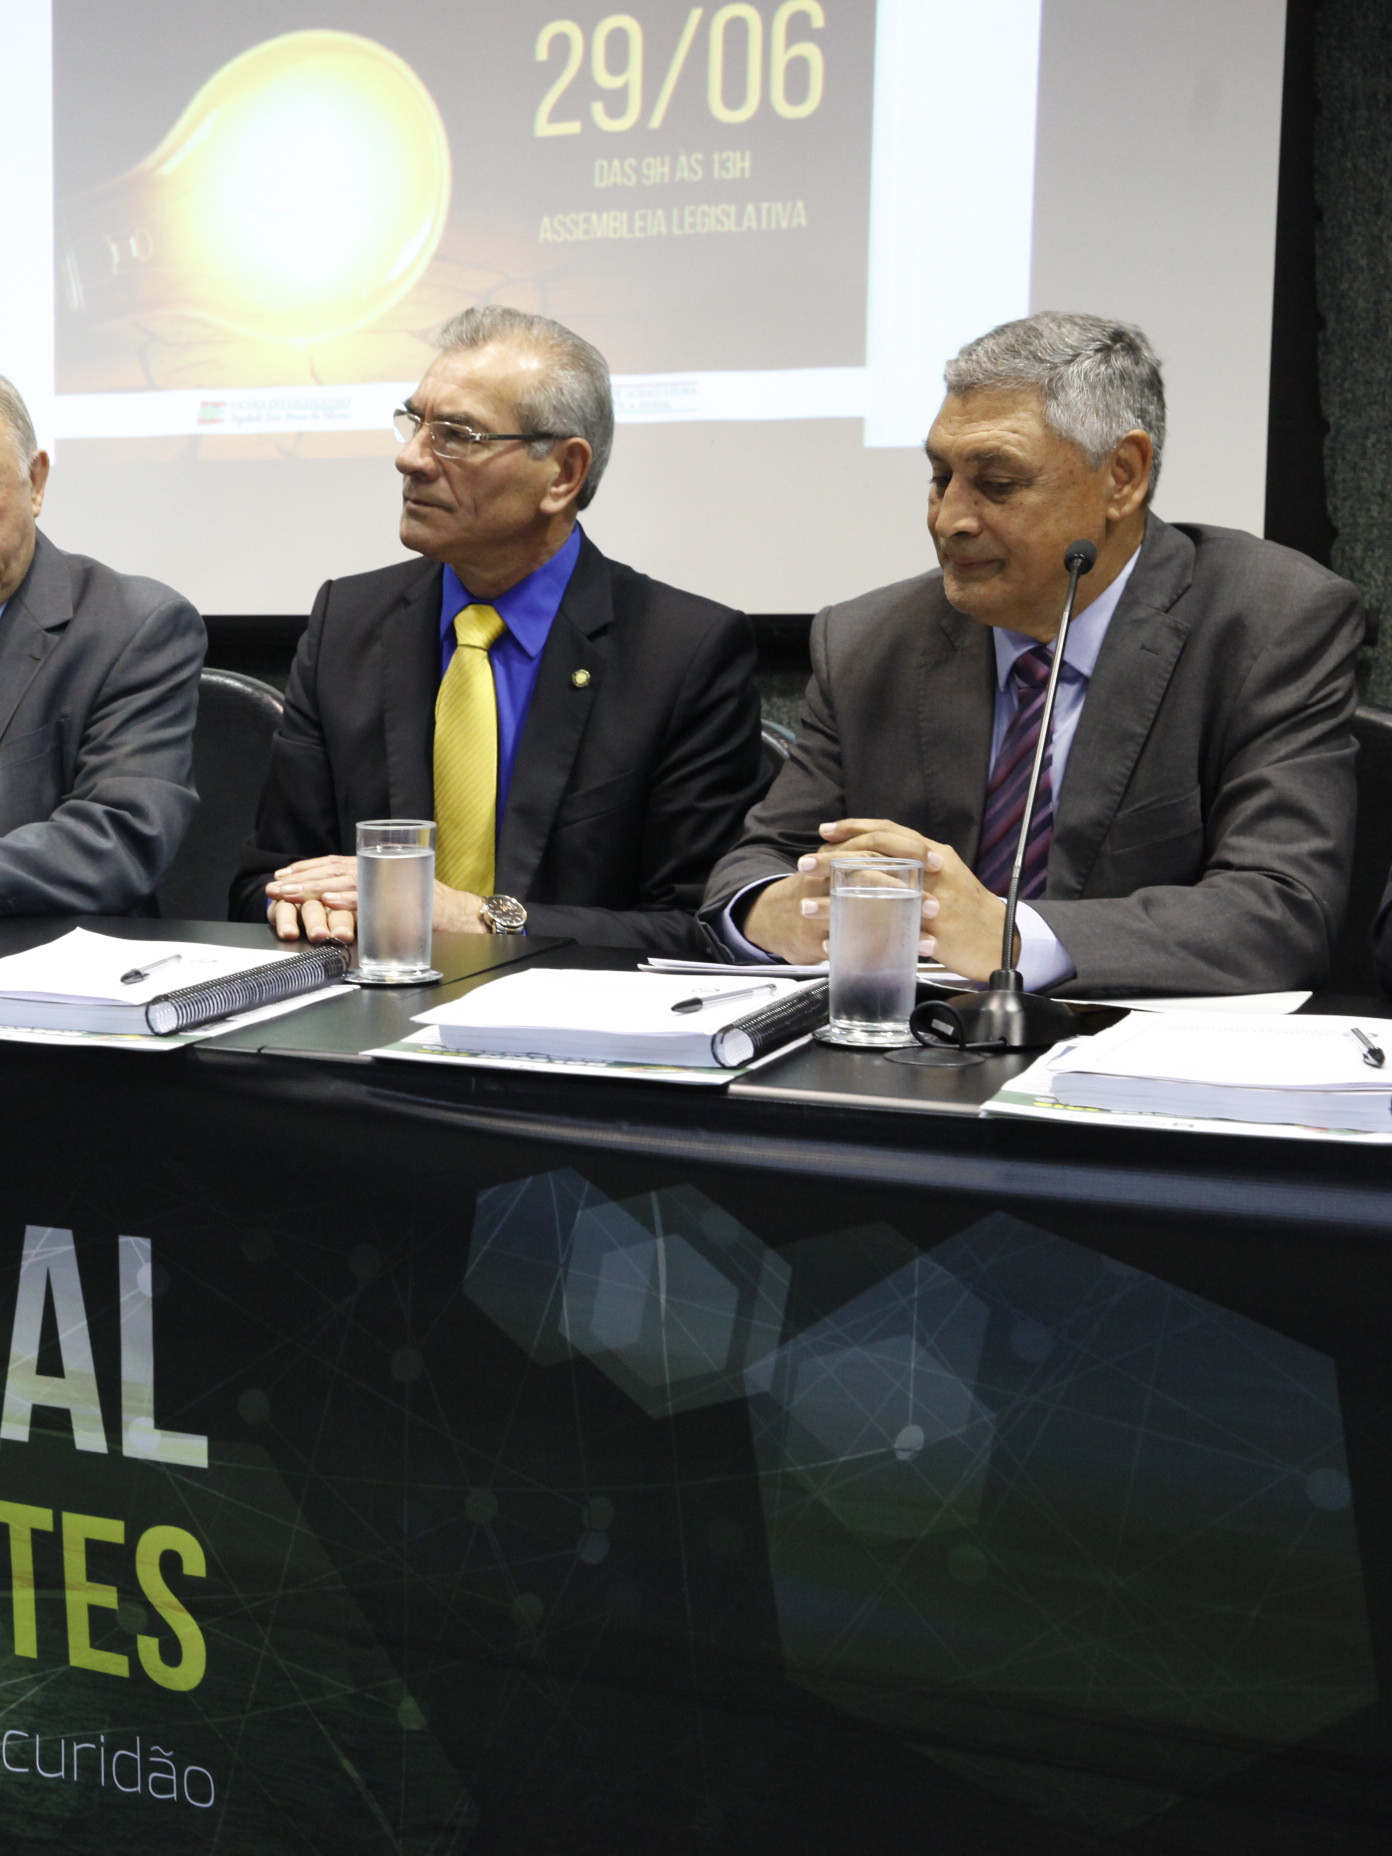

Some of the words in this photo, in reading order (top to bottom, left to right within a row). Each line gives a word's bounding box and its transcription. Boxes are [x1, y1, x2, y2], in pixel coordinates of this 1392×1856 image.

[534, 0, 826, 138] 29/06
[594, 158, 637, 188] DAS
[642, 155, 670, 186] 9H
[711, 149, 752, 180] 13H
[539, 208, 667, 243] ASSEMBLEIA
[672, 199, 807, 235] LEGISLATIVA
